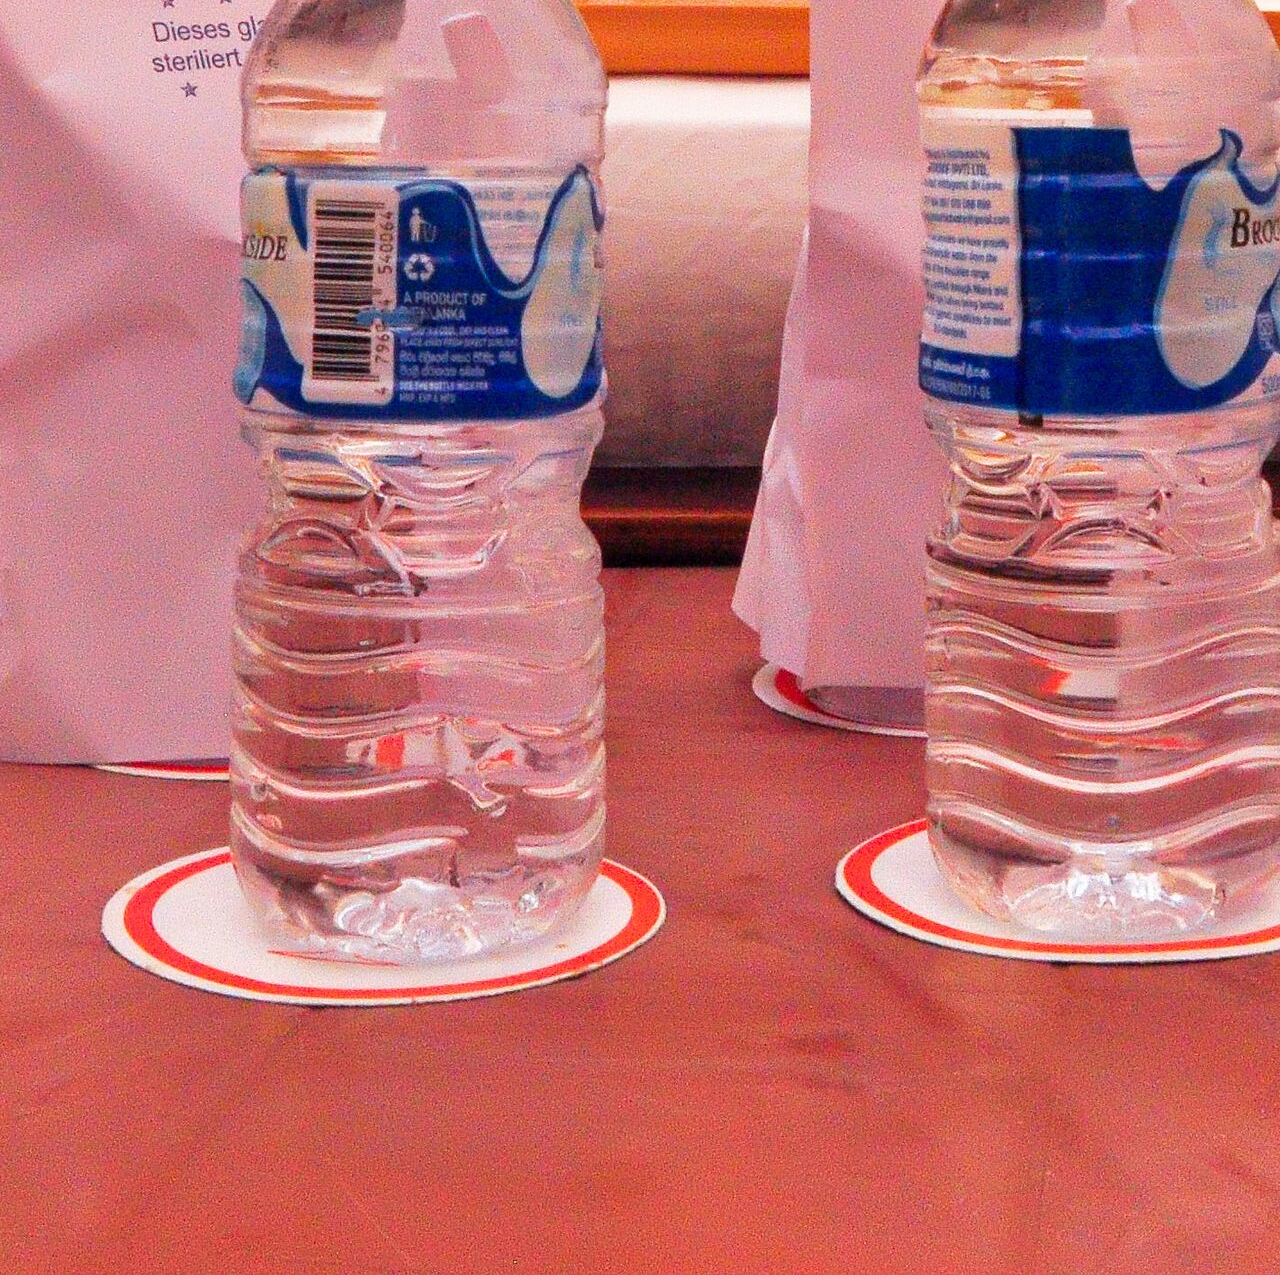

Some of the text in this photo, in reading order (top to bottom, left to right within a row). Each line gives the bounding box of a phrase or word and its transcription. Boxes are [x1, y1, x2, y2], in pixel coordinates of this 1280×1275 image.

[152, 21, 230, 43] Dieses
[152, 48, 243, 73] steriliert
[414, 291, 468, 306] PRODUCT
[470, 292, 488, 306] OF
